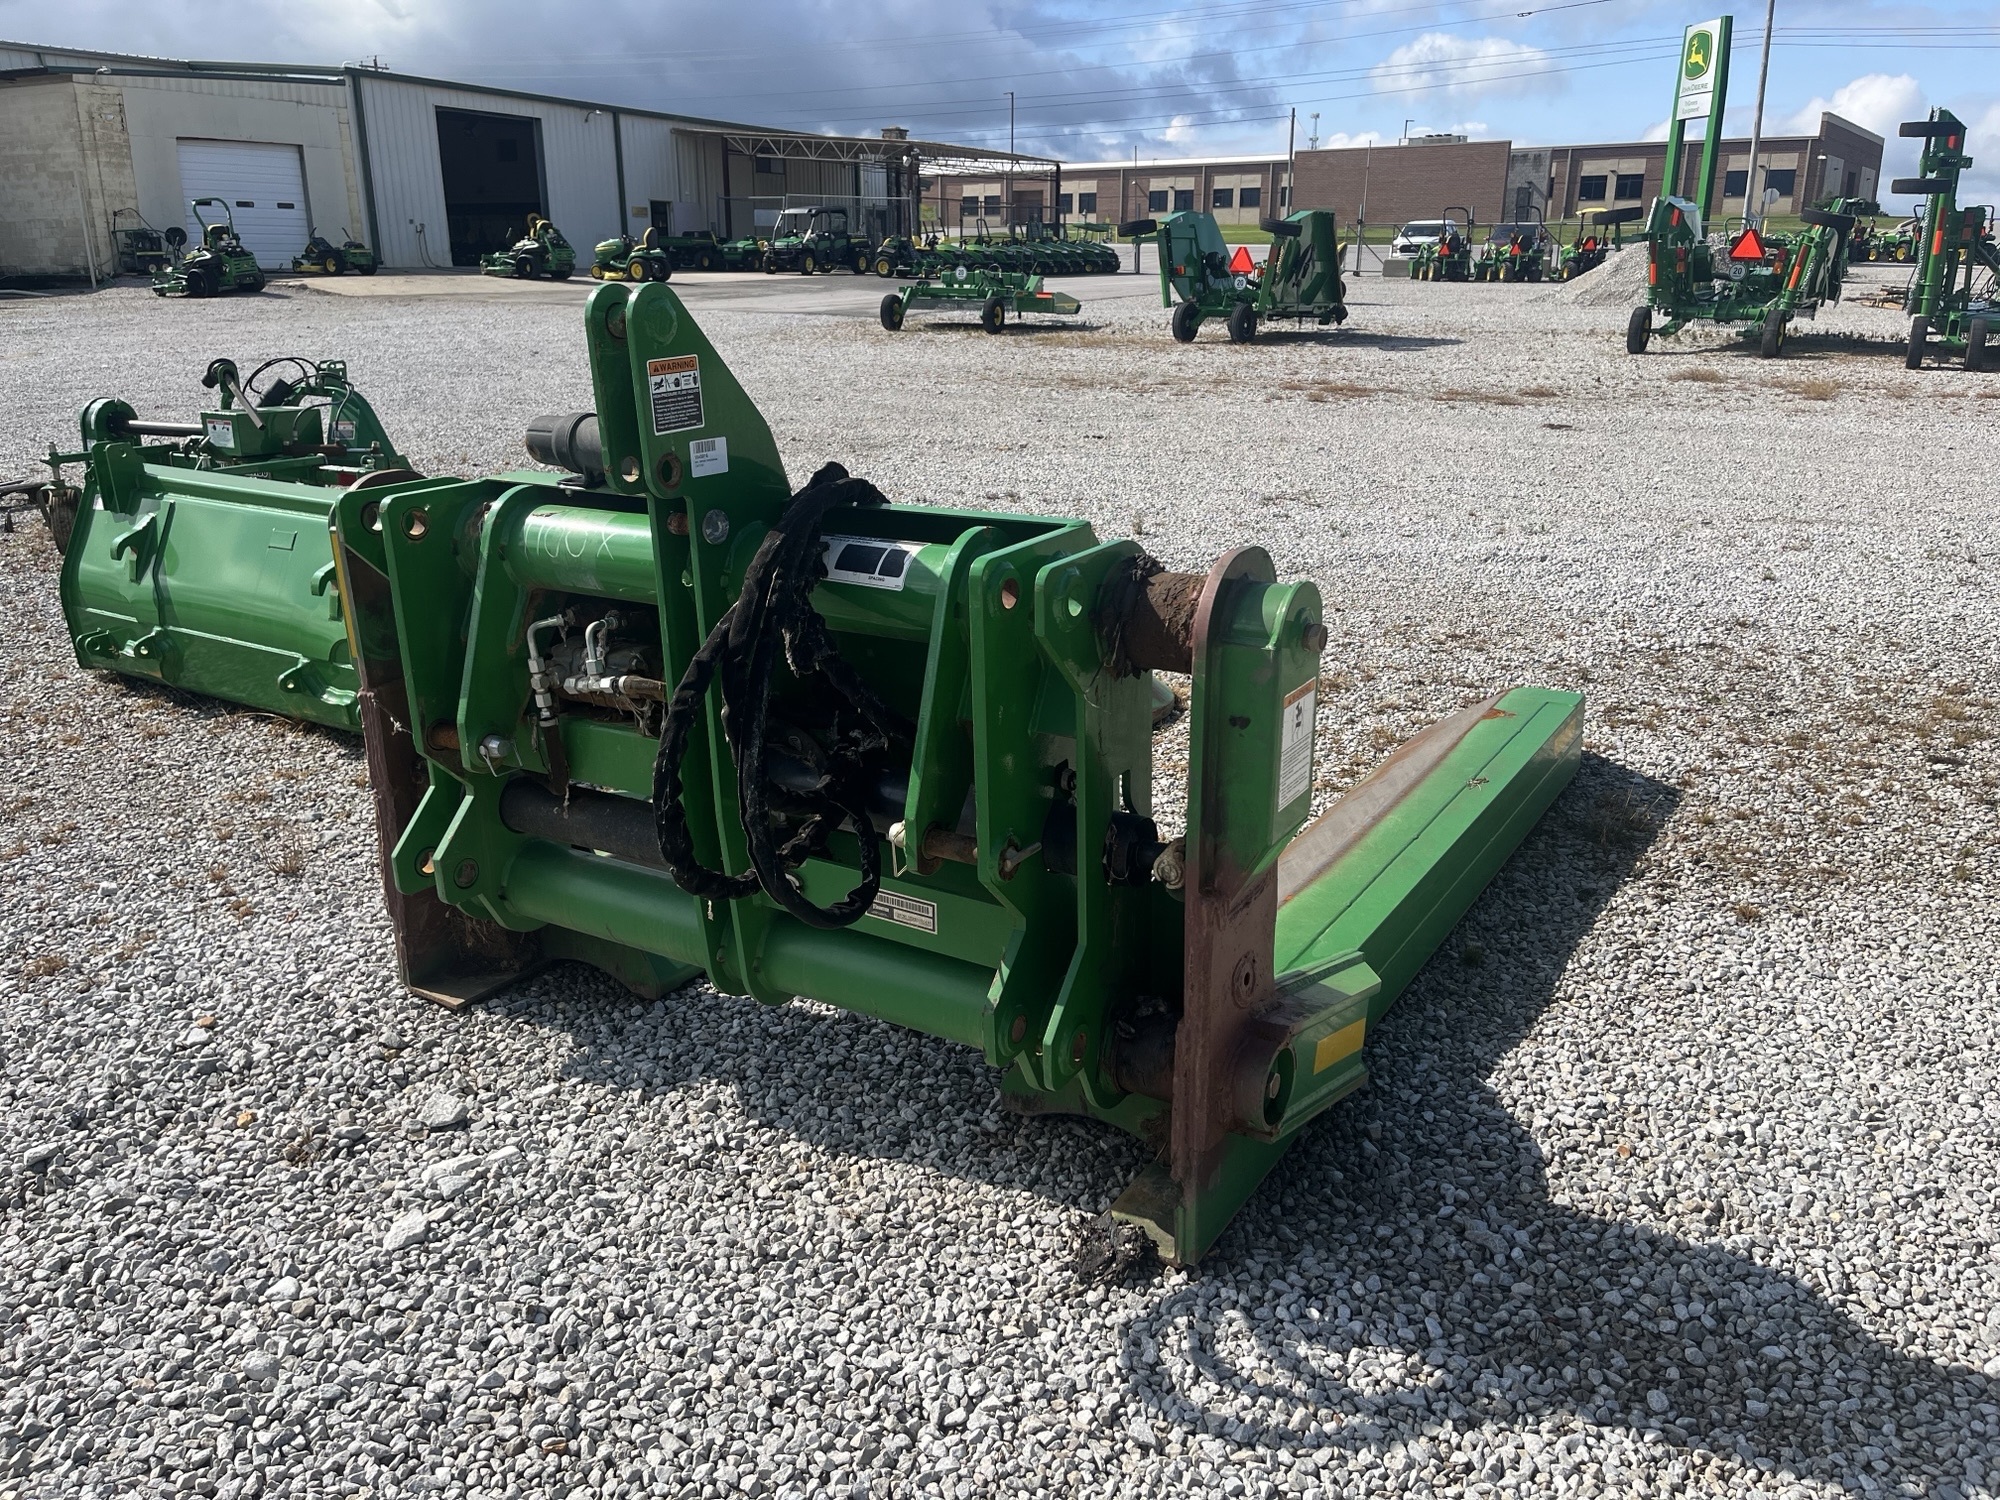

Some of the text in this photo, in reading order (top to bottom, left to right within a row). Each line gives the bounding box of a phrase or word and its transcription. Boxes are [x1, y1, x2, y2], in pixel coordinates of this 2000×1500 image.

[1691, 83, 1709, 91] DEERE
[1732, 267, 1743, 275] 20
[1236, 279, 1244, 287] 20
[660, 359, 695, 372] WARNING
